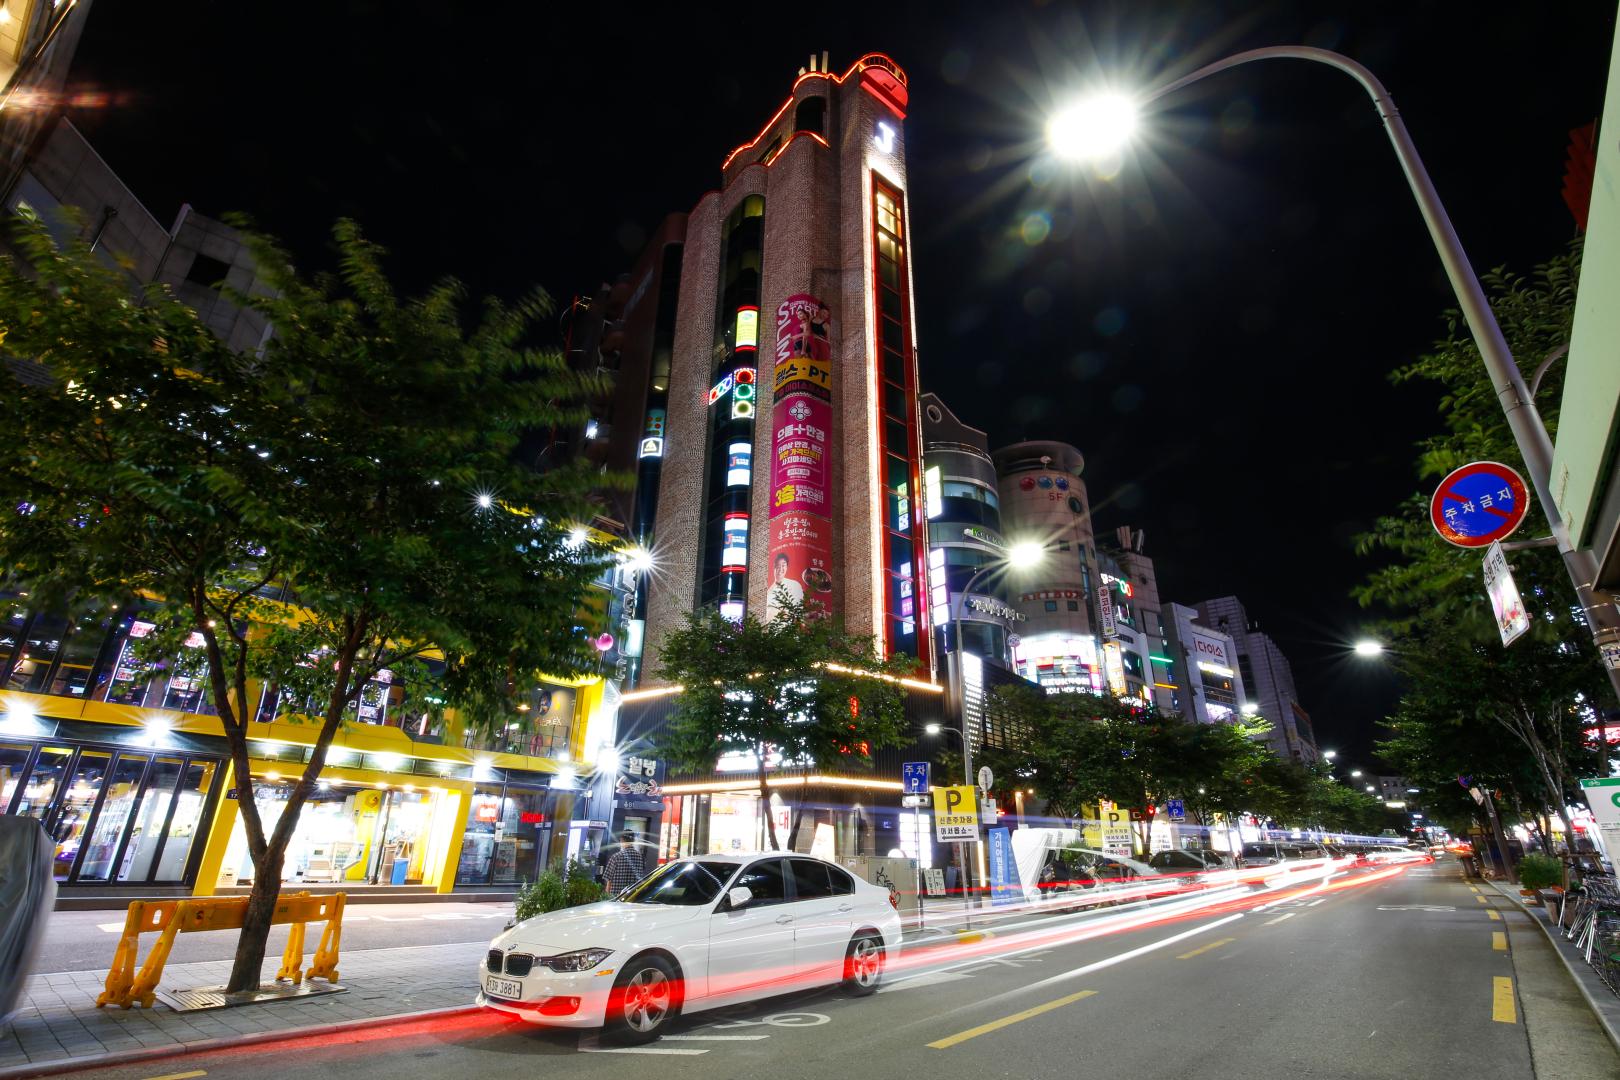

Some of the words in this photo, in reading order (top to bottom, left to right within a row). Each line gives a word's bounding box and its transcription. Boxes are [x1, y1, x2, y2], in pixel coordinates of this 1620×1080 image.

[874, 121, 896, 154] J
[1444, 486, 1513, 526] 주차금지
[1197, 640, 1224, 658] 다이소
[905, 764, 926, 777] 주차
[911, 778, 919, 791] P
[945, 789, 962, 816] P
[1108, 812, 1120, 828] P
[500, 981, 516, 996] 3881
